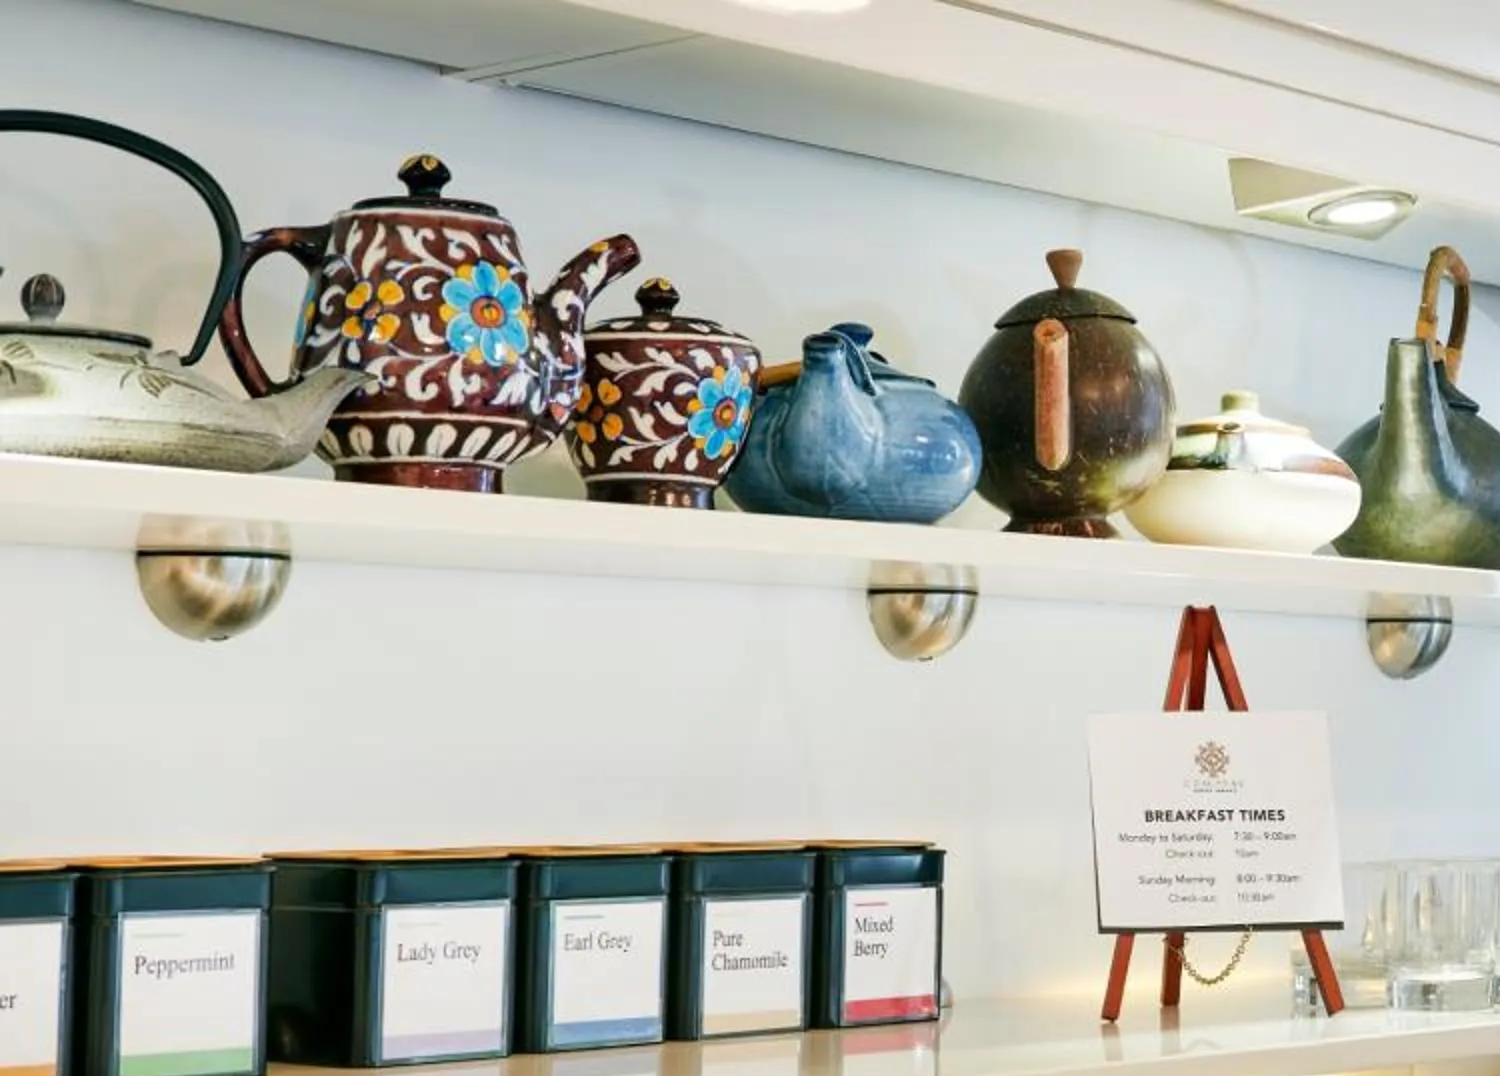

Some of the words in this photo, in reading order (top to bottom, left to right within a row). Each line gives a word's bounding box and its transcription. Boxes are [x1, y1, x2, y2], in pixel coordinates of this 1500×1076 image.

[1144, 808, 1234, 823] BREAKFAST
[1239, 808, 1286, 823] TIMES
[1118, 832, 1157, 845] Monday
[1159, 832, 1169, 843] to
[1137, 874, 1173, 888] Sunday
[855, 916, 894, 935] Mixed
[563, 931, 594, 951] Earl
[598, 931, 632, 954] Grey
[712, 929, 744, 949] Pure
[396, 943, 437, 966] Lady
[442, 940, 482, 963] Grey
[854, 939, 889, 960] Berry
[134, 950, 236, 979] Peppermint
[711, 951, 789, 973] Chamomile
